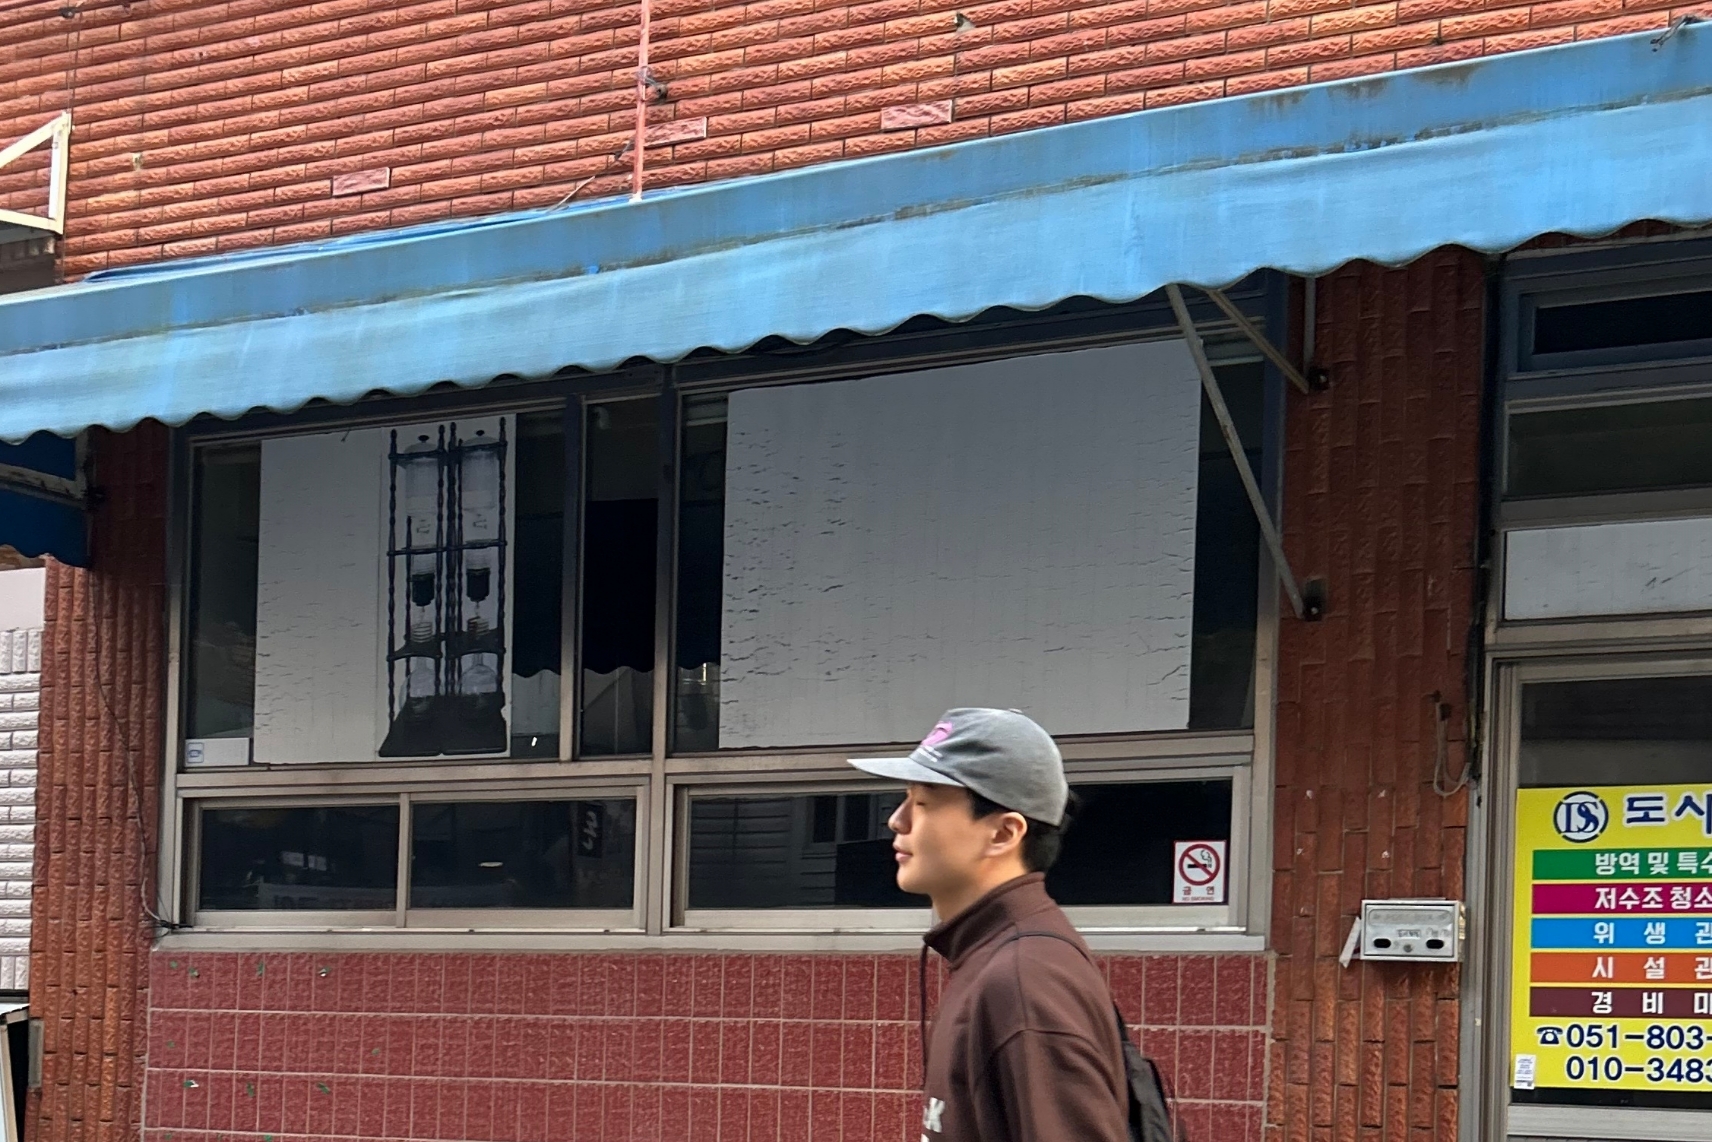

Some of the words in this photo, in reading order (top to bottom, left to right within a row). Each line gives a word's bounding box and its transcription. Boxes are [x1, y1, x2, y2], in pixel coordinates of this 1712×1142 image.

[1594, 852, 1641, 875] 방역
[1647, 852, 1669, 875] 및
[1594, 887, 1664, 910] 저수조
[1669, 886, 1712, 910] 청소
[1566, 1024, 1712, 1050] 051-803
